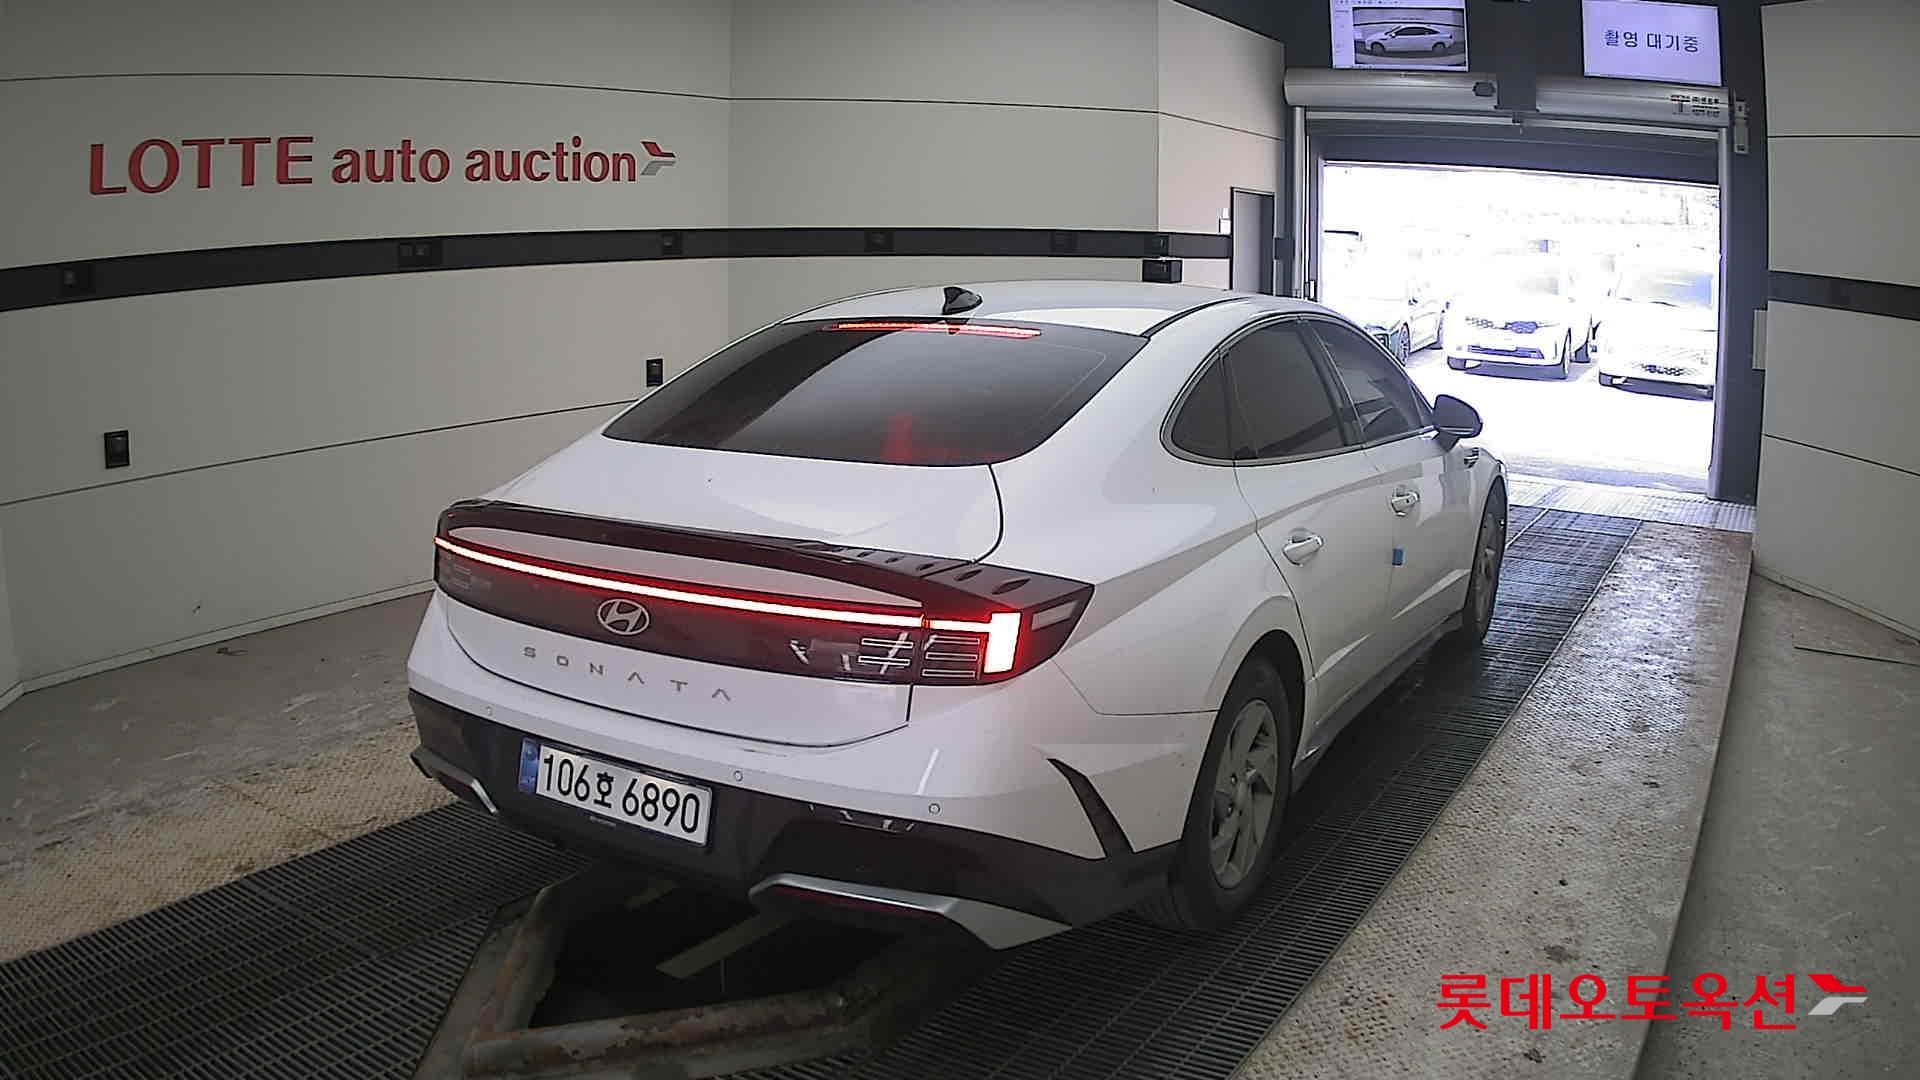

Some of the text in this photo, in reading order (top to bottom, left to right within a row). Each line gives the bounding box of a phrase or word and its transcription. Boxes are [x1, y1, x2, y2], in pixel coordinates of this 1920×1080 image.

[1604, 29, 1699, 53] 촬영 대기중
[89, 135, 638, 195] LOTTE auto auction
[523, 646, 732, 702] SONATA
[543, 753, 701, 834] 106호 6890
